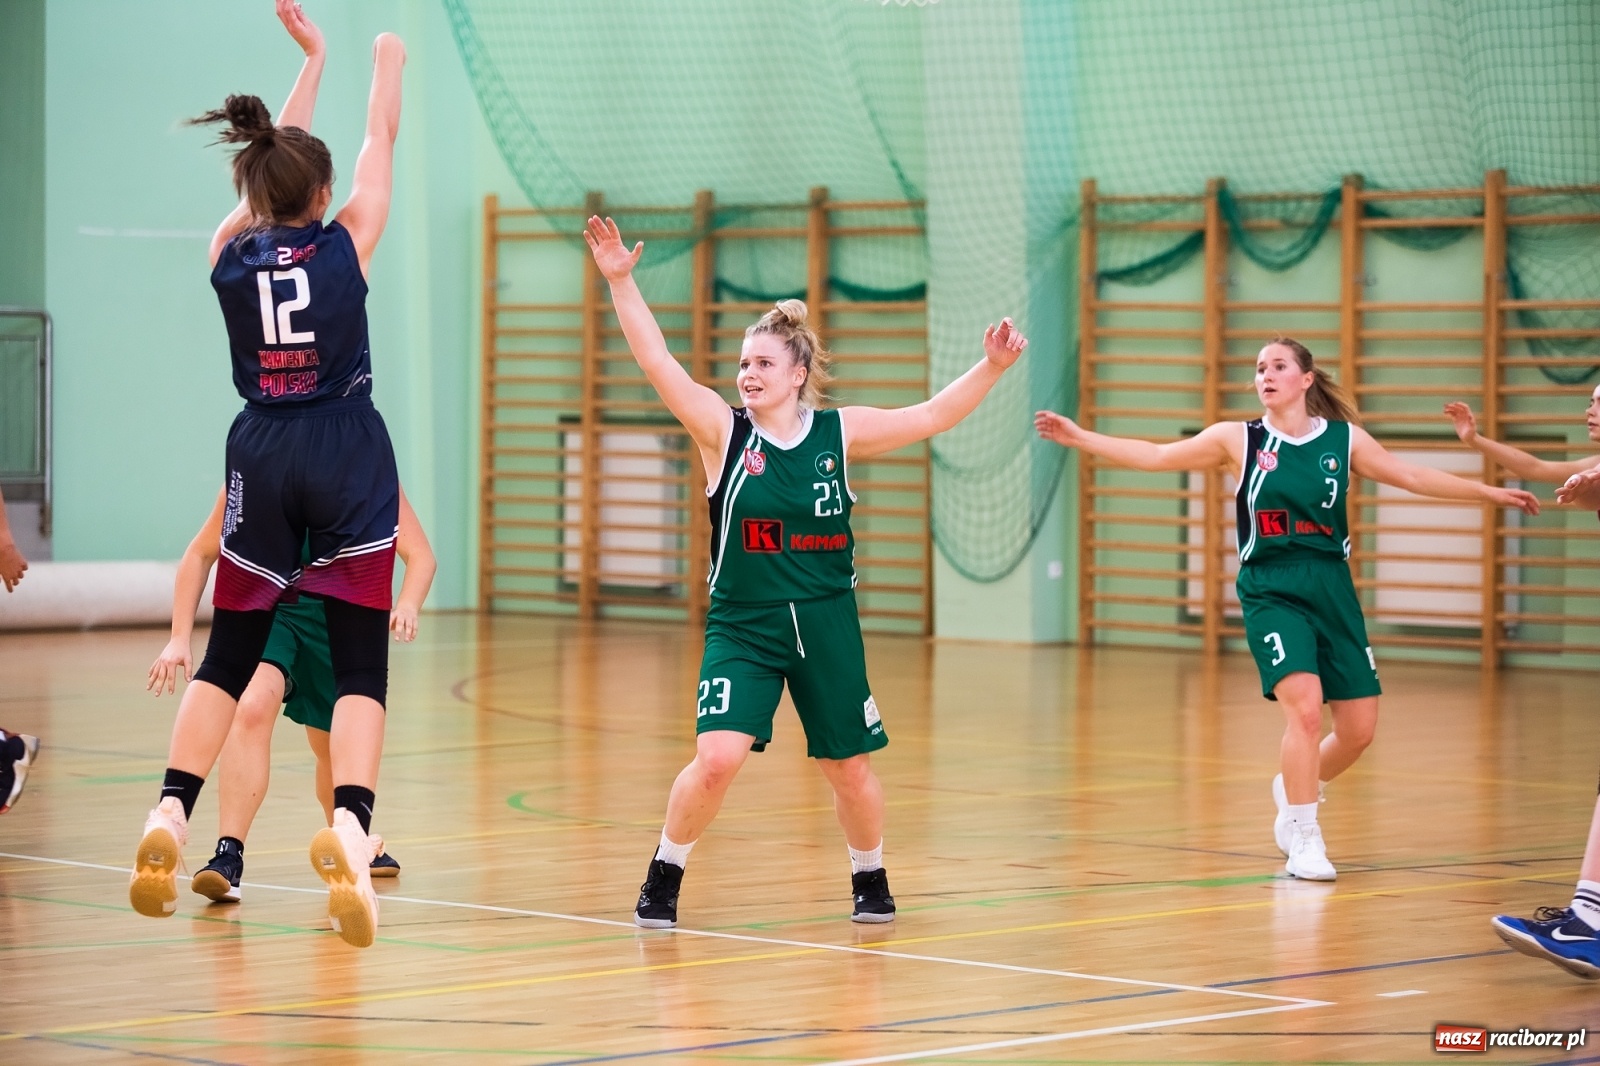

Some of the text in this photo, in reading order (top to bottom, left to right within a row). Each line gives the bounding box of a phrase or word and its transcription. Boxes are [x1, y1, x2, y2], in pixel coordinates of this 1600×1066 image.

[256, 267, 316, 345] 12
[258, 349, 320, 369] KAMIENICA
[259, 371, 318, 398] POLSKA
[812, 479, 843, 517] 23
[1321, 477, 1338, 509] 3
[746, 522, 778, 550] K
[1263, 631, 1286, 666] 3
[697, 677, 732, 719] 23
